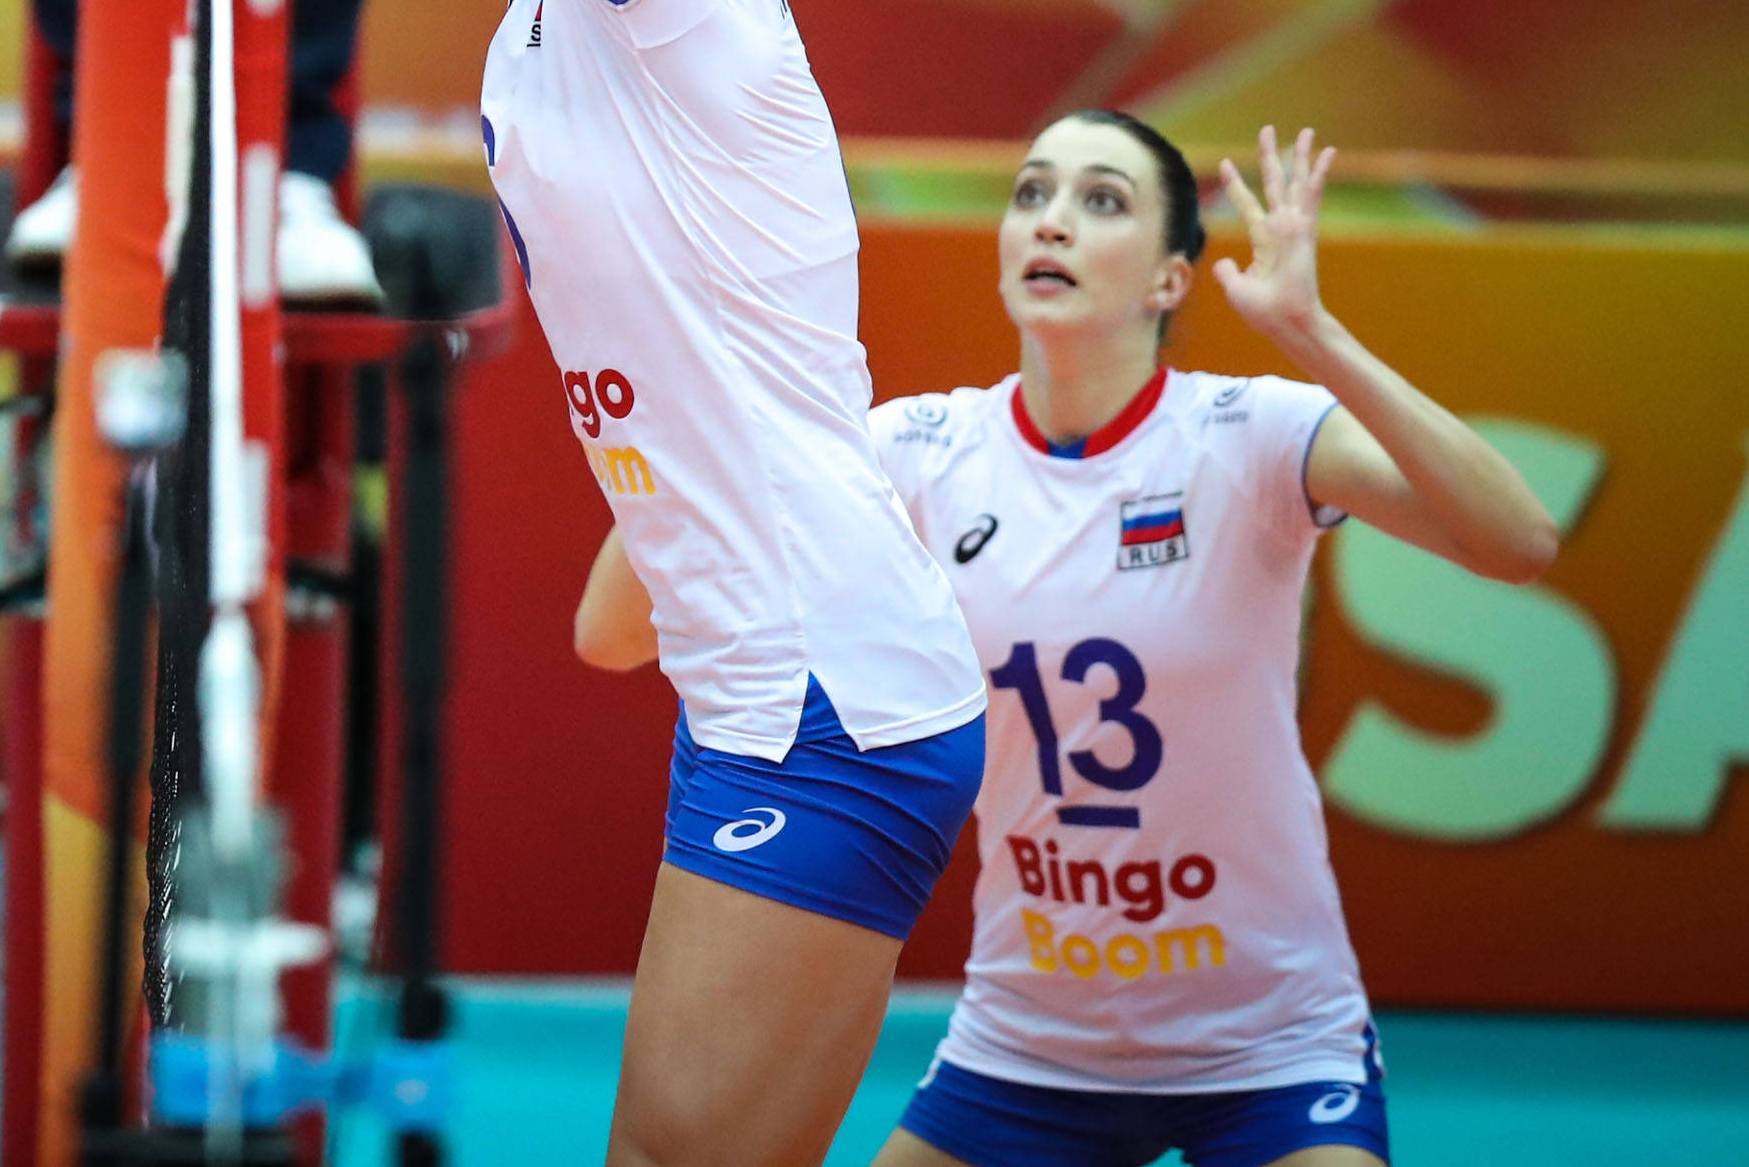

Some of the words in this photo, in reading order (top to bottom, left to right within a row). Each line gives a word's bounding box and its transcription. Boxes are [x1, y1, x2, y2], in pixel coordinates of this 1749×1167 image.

[1130, 541, 1177, 563] RUS
[989, 637, 1163, 797] 13
[1005, 834, 1217, 923] Bingo
[1021, 907, 1227, 979] Boom
